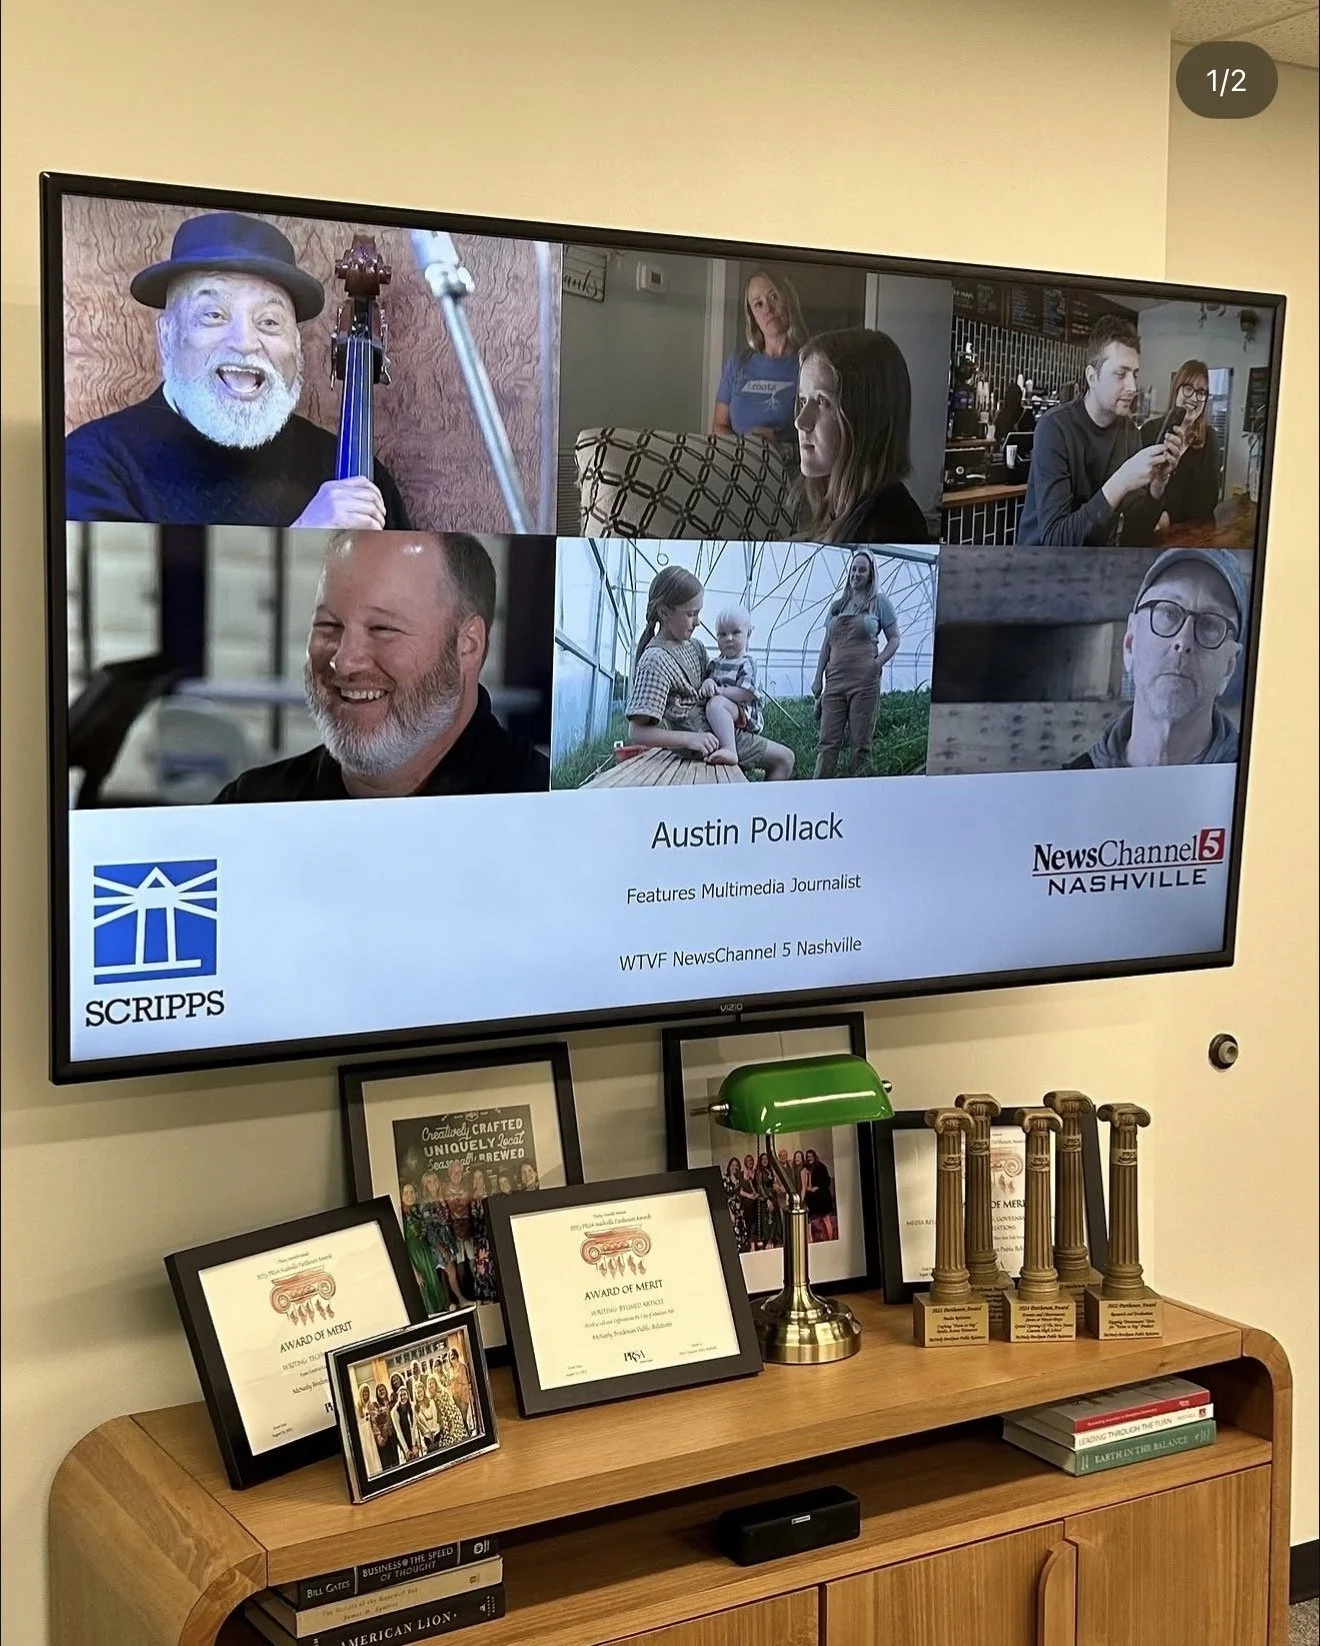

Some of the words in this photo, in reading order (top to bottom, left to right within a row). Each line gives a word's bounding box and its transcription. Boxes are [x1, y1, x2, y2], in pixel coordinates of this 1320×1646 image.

[650, 818, 739, 849] Austin
[751, 812, 844, 843] Pollack
[627, 888, 696, 904] Features
[701, 879, 785, 899] Multimedia
[790, 874, 861, 893] Journalist
[1048, 868, 1207, 896] NASHVILLE
[619, 952, 667, 971] WTVF
[673, 943, 776, 967] NewsChannel
[782, 942, 791, 957] 5
[797, 936, 862, 955] Nashville
[85, 990, 225, 1027] SCRIPPS
[720, 1003, 743, 1013] VIZIO
[421, 1122, 471, 1142] Creatively
[472, 1117, 523, 1135] CRAFTED
[424, 1137, 496, 1157] UNIQUELY
[479, 1148, 524, 1162] BREWED
[1003, 1200, 1025, 1208] MER
[584, 1286, 620, 1301] AWARD
[621, 1284, 633, 1294] OF
[635, 1279, 663, 1292] MERIT
[280, 1336, 313, 1353] AWARD
[314, 1329, 326, 1341] OF
[326, 1321, 353, 1336] MERIT
[1078, 1432, 1107, 1446] LEADING
[1108, 1425, 1141, 1438] THROUGH
[1141, 1422, 1154, 1430] THE
[1155, 1418, 1173, 1427] TURN
[1095, 1450, 1122, 1464] EARTH
[1123, 1448, 1134, 1457] IN
[1134, 1444, 1152, 1456] THE
[1152, 1436, 1188, 1451] BALANCE
[362, 1560, 402, 1578] BUSINESS
[408, 1555, 425, 1567] THE
[428, 1546, 454, 1560] SPEED
[380, 1572, 391, 1582] OF
[395, 1560, 437, 1578] THOUGHT
[307, 1588, 324, 1599] BILL
[325, 1580, 351, 1593] GATES
[418, 1611, 452, 1630] LION
